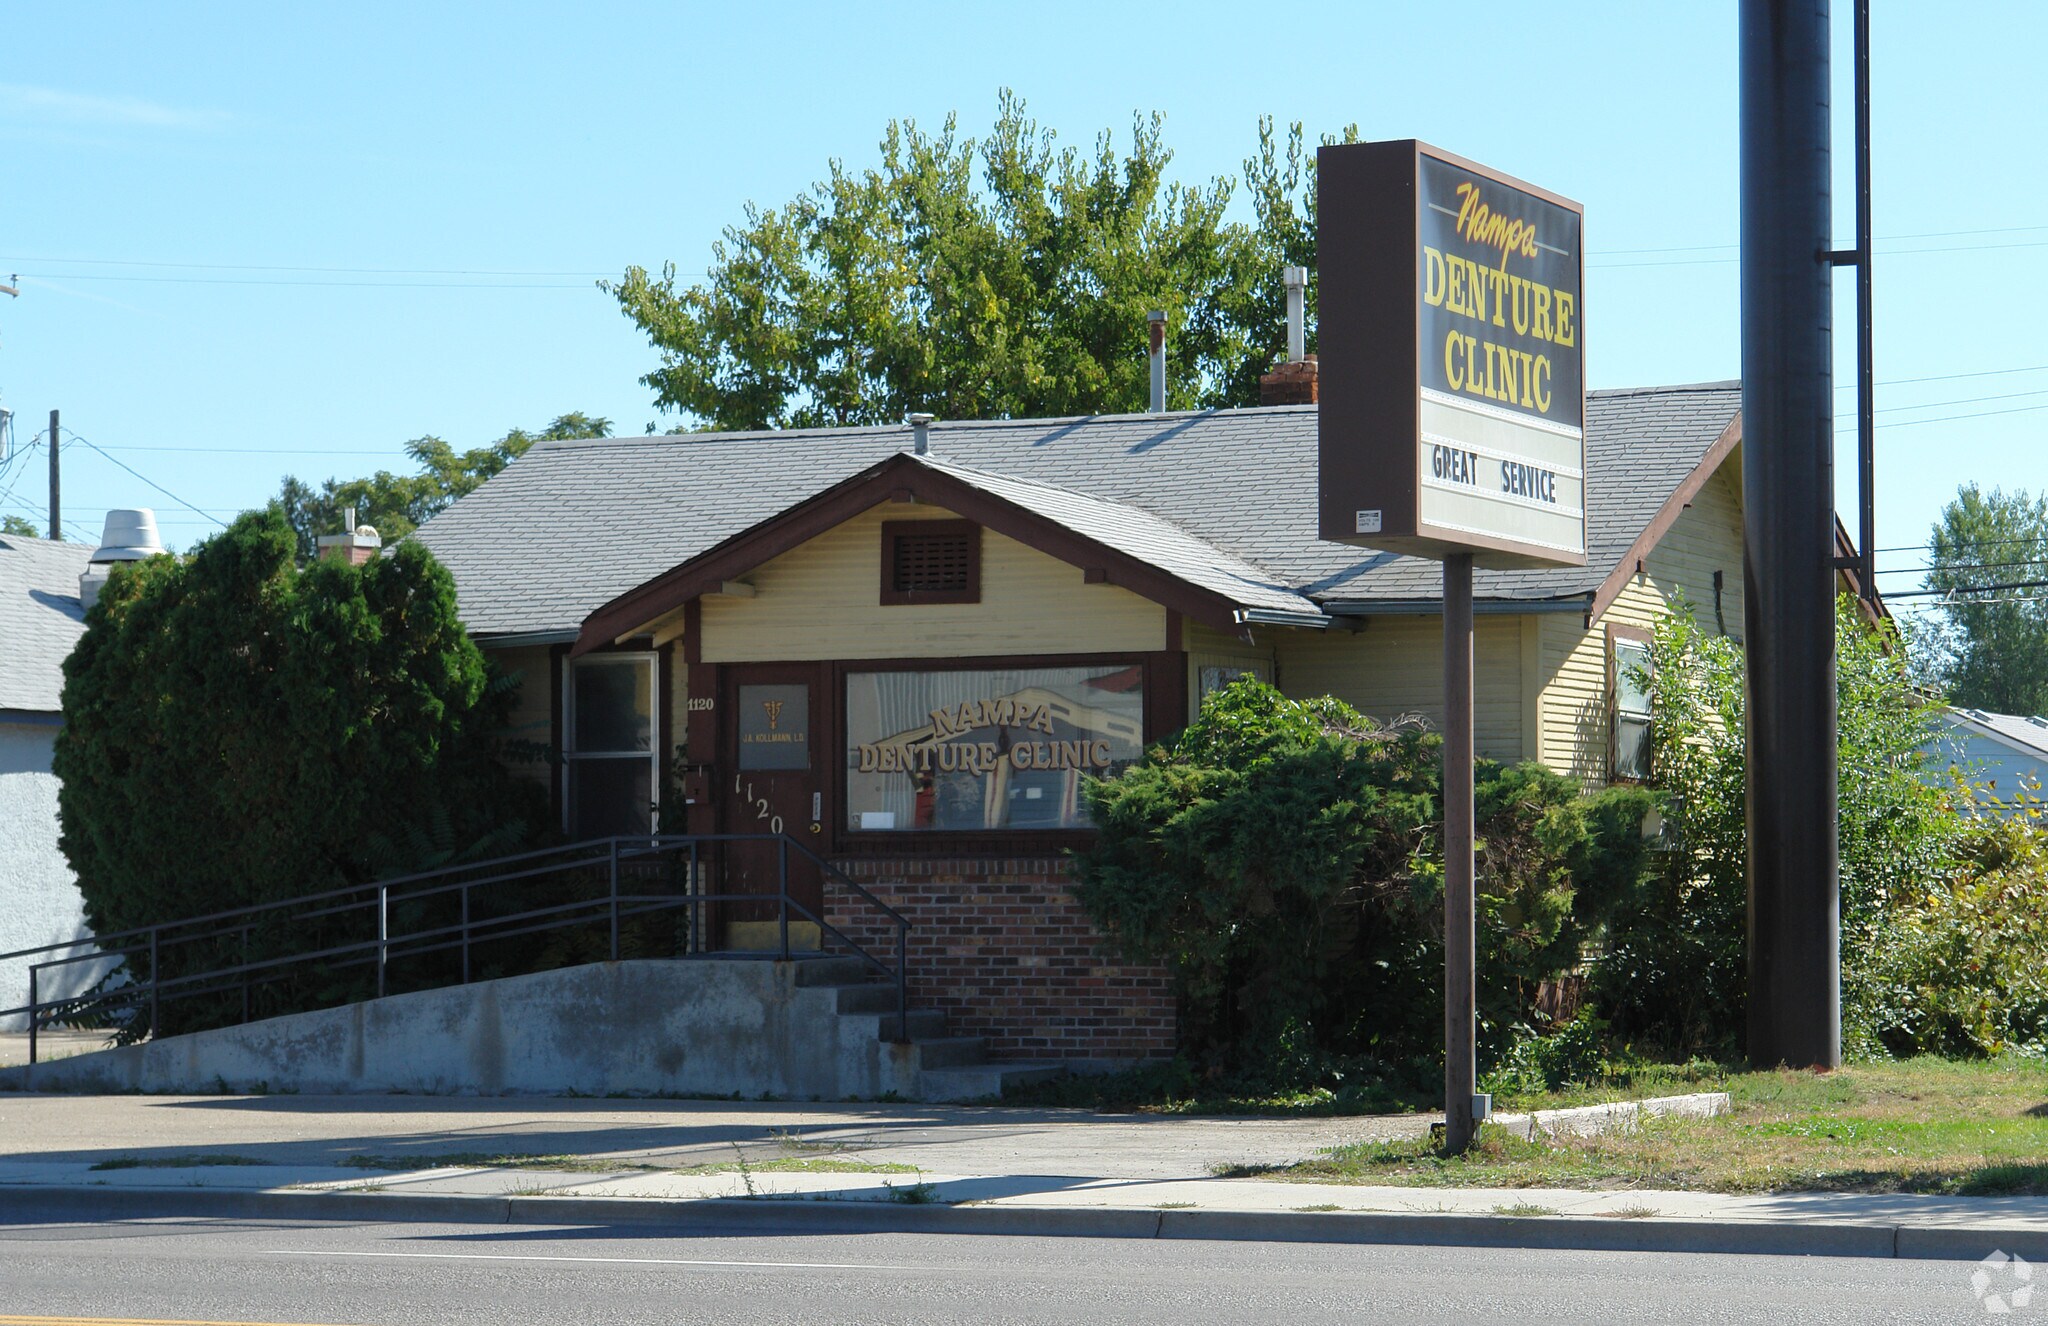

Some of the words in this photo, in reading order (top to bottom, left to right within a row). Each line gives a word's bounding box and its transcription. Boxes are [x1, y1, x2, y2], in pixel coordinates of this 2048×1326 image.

[1456, 182, 1539, 274] Nampa
[1423, 246, 1575, 348] DENTURE
[1444, 329, 1552, 414] CLINIC
[1432, 443, 1479, 486] GREAT
[1501, 459, 1557, 504] SERVICE
[687, 698, 714, 711] 1120
[930, 699, 1054, 738] NAMPA
[858, 741, 1000, 778] DENTURE
[1009, 739, 1112, 771] CLINIC
[735, 773, 784, 834] 1120
